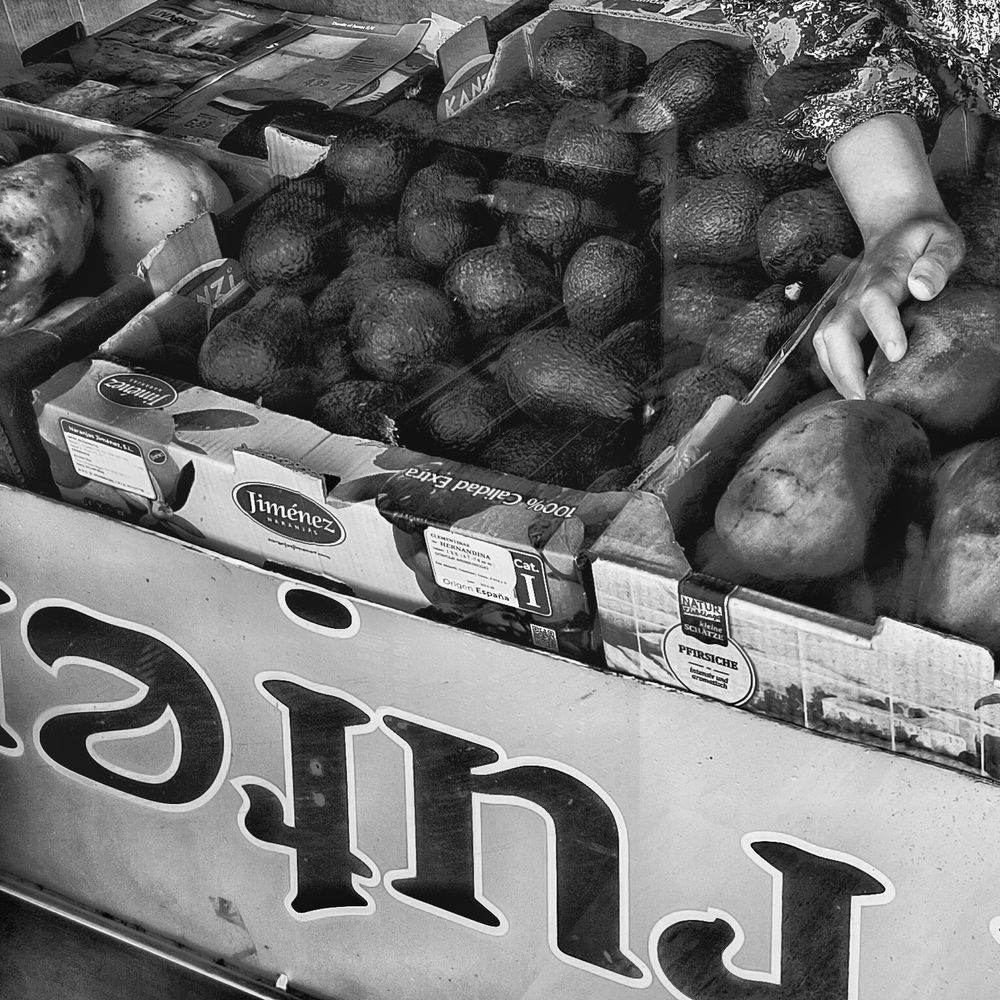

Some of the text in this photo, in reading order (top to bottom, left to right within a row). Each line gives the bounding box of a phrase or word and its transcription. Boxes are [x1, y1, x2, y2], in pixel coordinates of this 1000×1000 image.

[404, 467, 577, 518] 100% Calidad Extra
[246, 489, 336, 534] Jiménez
[440, 541, 492, 561] HERNANDINA
[513, 558, 540, 573] Cat.
[442, 578, 475, 593] Origen
[475, 586, 510, 602] España
[520, 572, 542, 608] I
[681, 595, 723, 615] NATUR
[678, 644, 739, 671] PFIRSICHE
